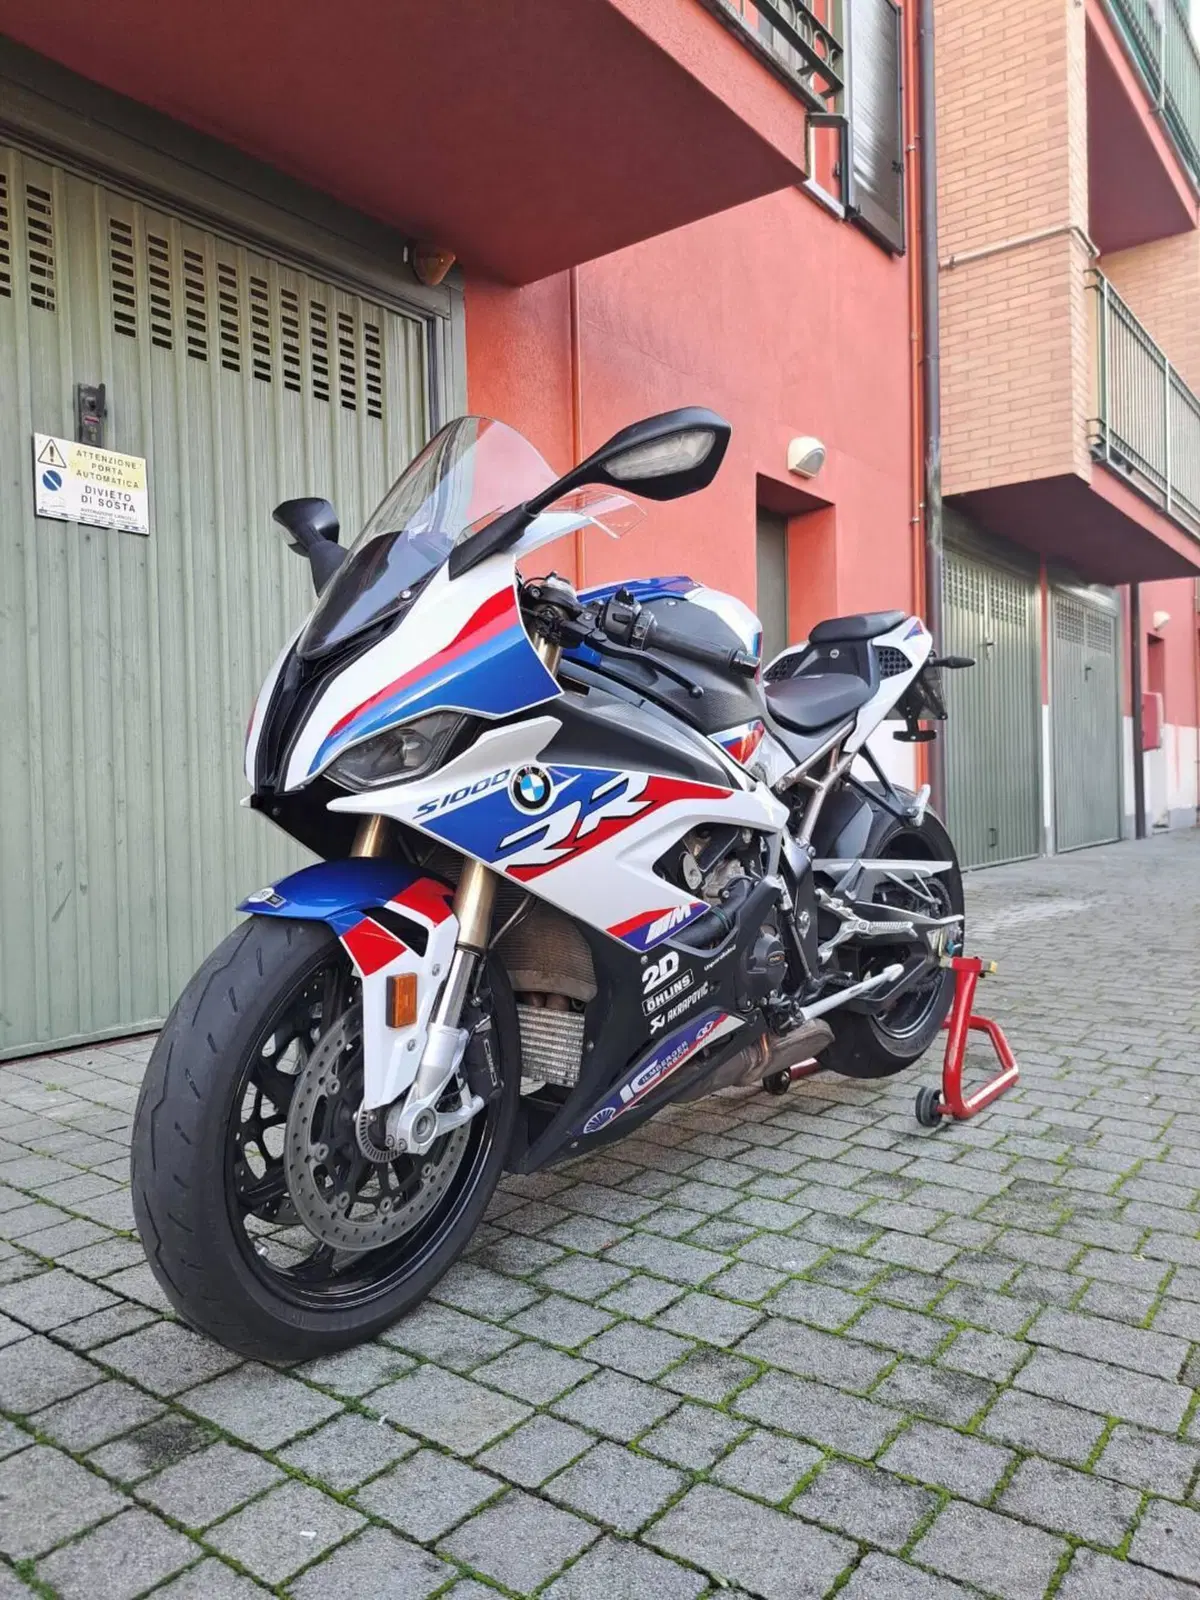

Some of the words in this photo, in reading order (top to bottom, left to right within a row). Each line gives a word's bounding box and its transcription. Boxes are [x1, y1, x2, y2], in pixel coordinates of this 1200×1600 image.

[76, 449, 137, 470] ATTENZIONE
[91, 463, 123, 476] PORTA
[76, 469, 140, 489] AUTOMATICA
[85, 485, 132, 502] DIVIETO
[81, 495, 93, 504] DI
[98, 498, 136, 513] SOSTA
[412, 768, 511, 820] S1000
[492, 773, 653, 866] RR
[641, 951, 680, 994] 2D
